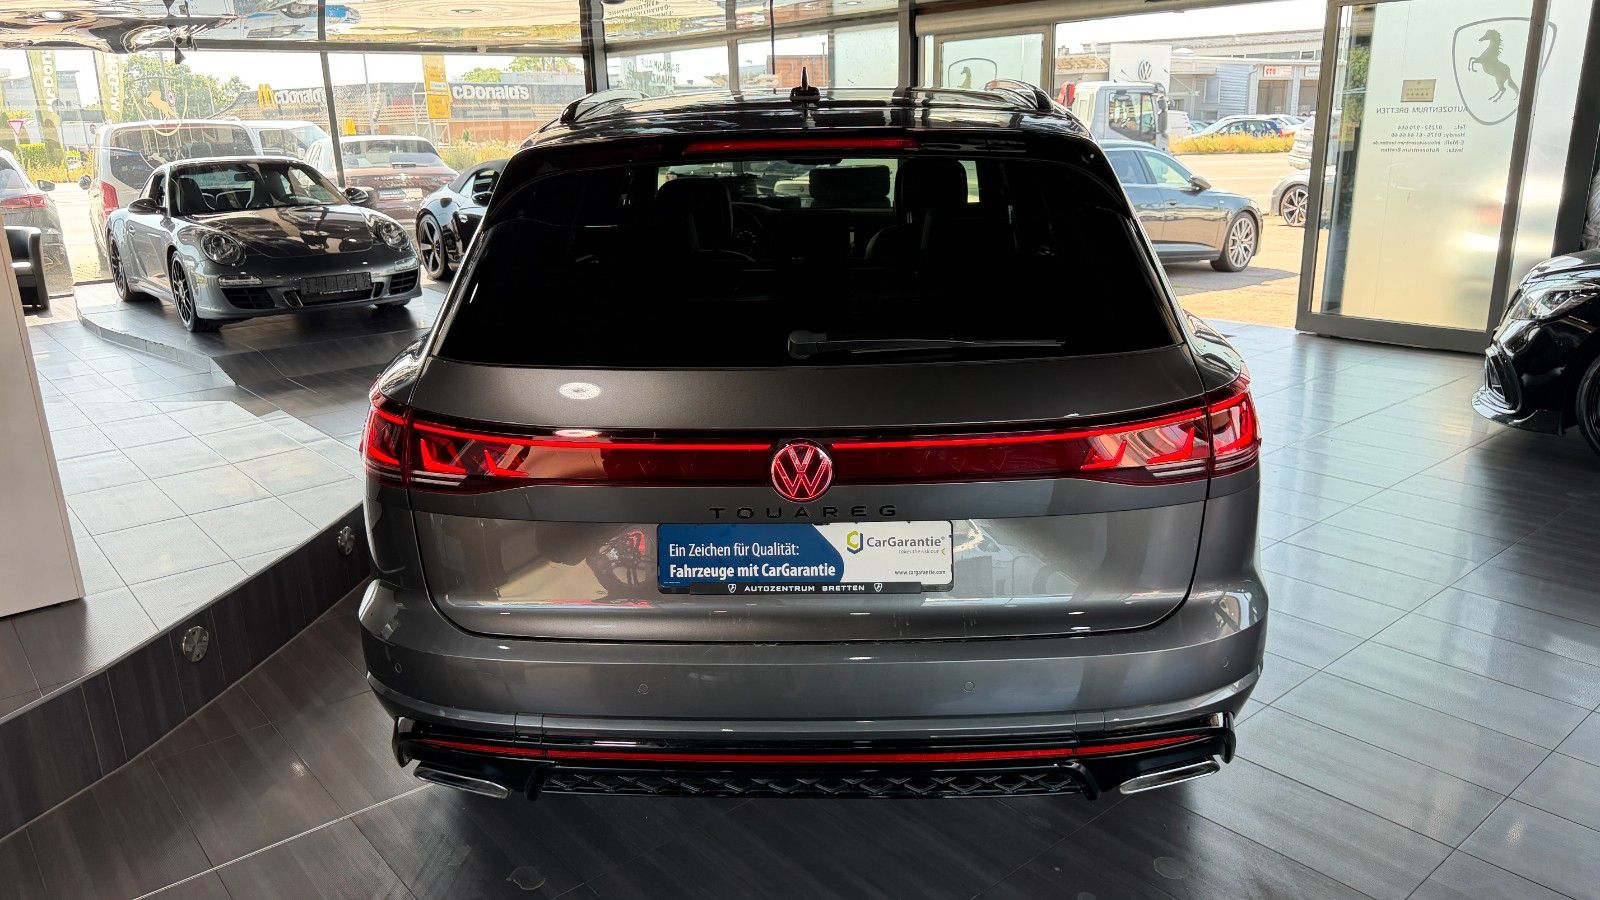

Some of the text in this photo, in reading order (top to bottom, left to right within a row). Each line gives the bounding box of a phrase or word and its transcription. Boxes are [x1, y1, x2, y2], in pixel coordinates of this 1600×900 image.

[41, 50, 55, 112] McDon
[449, 84, 529, 100] cDonald's
[709, 504, 897, 519] TOUAREG
[669, 541, 800, 558] Ein Zeichen für Qualität:
[669, 562, 836, 581] Fahrzeuge mit CarGarantie
[744, 585, 815, 593] AUTOZENTRUM
